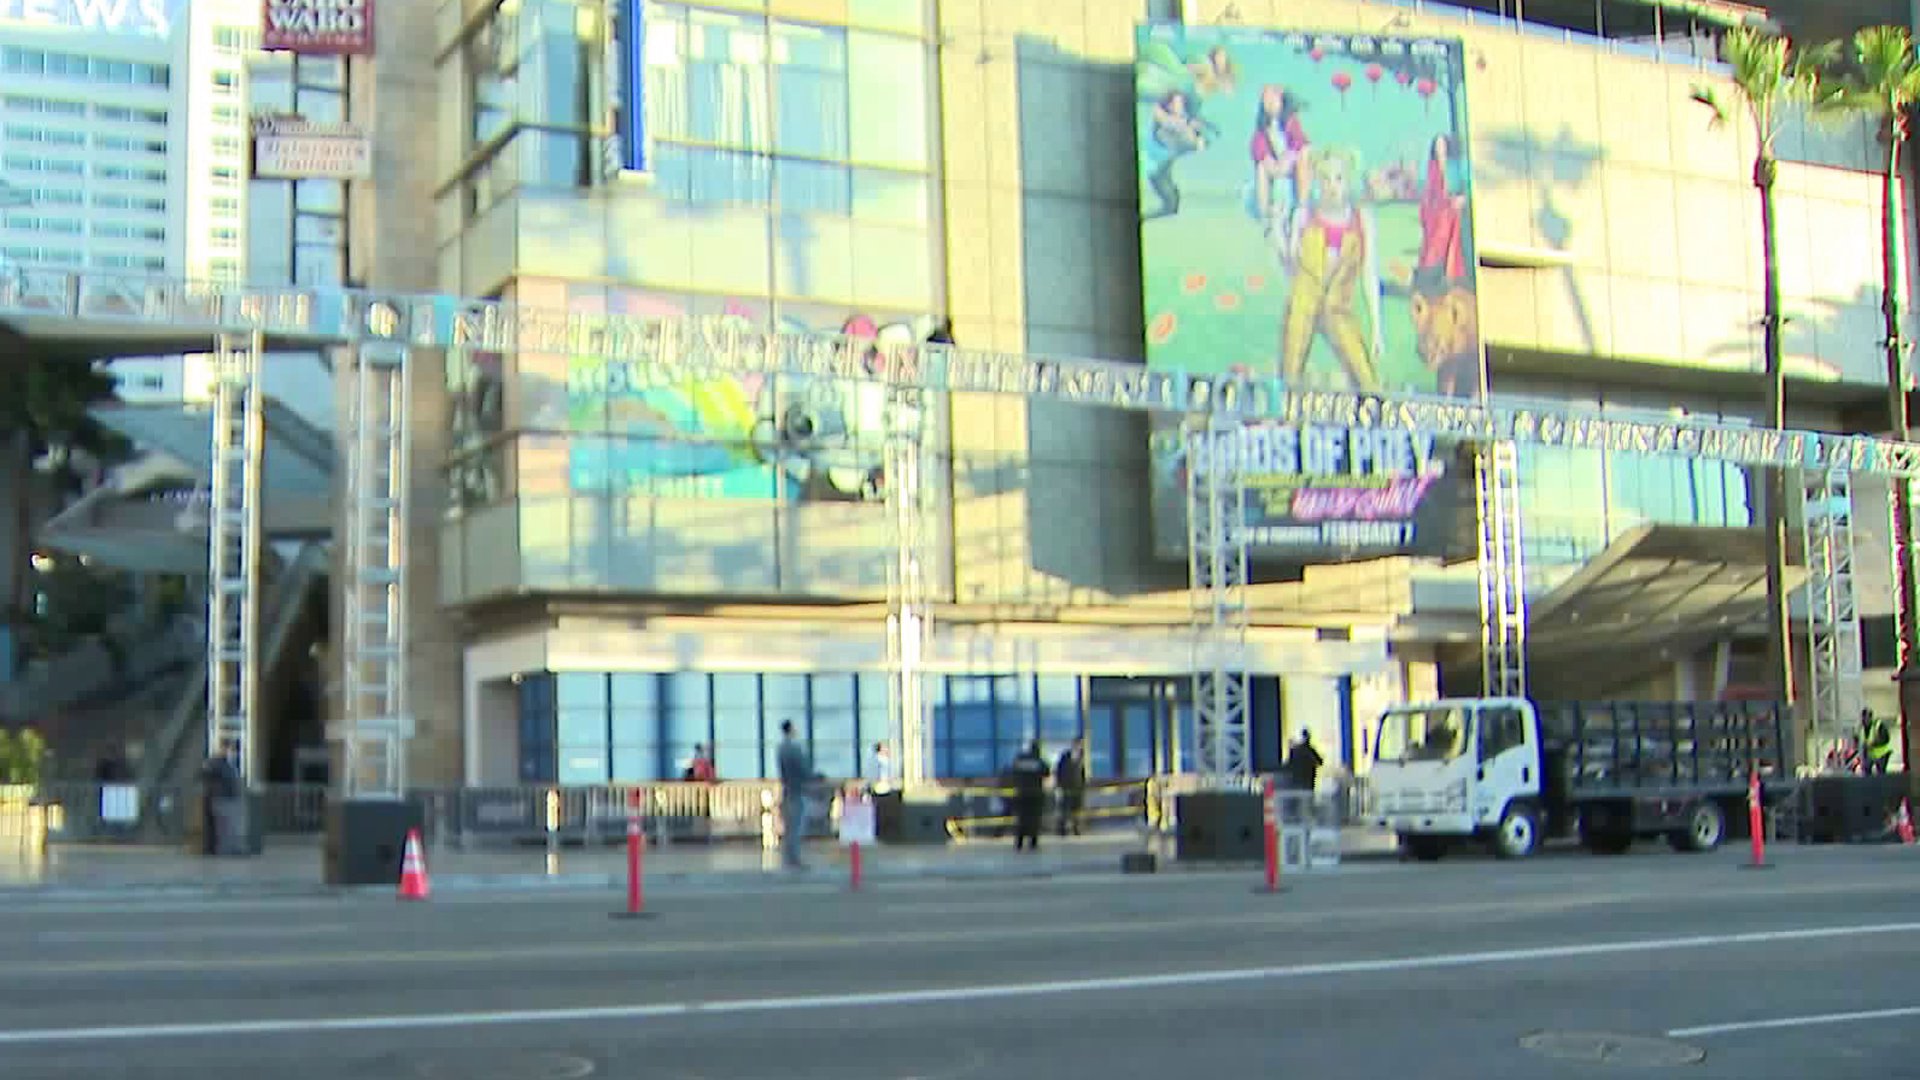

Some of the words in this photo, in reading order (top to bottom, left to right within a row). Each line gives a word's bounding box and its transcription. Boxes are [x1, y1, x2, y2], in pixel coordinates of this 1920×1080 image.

[269, 7, 364, 33] WABO
[1301, 429, 1347, 476] OF
[1350, 430, 1436, 477] PREY
